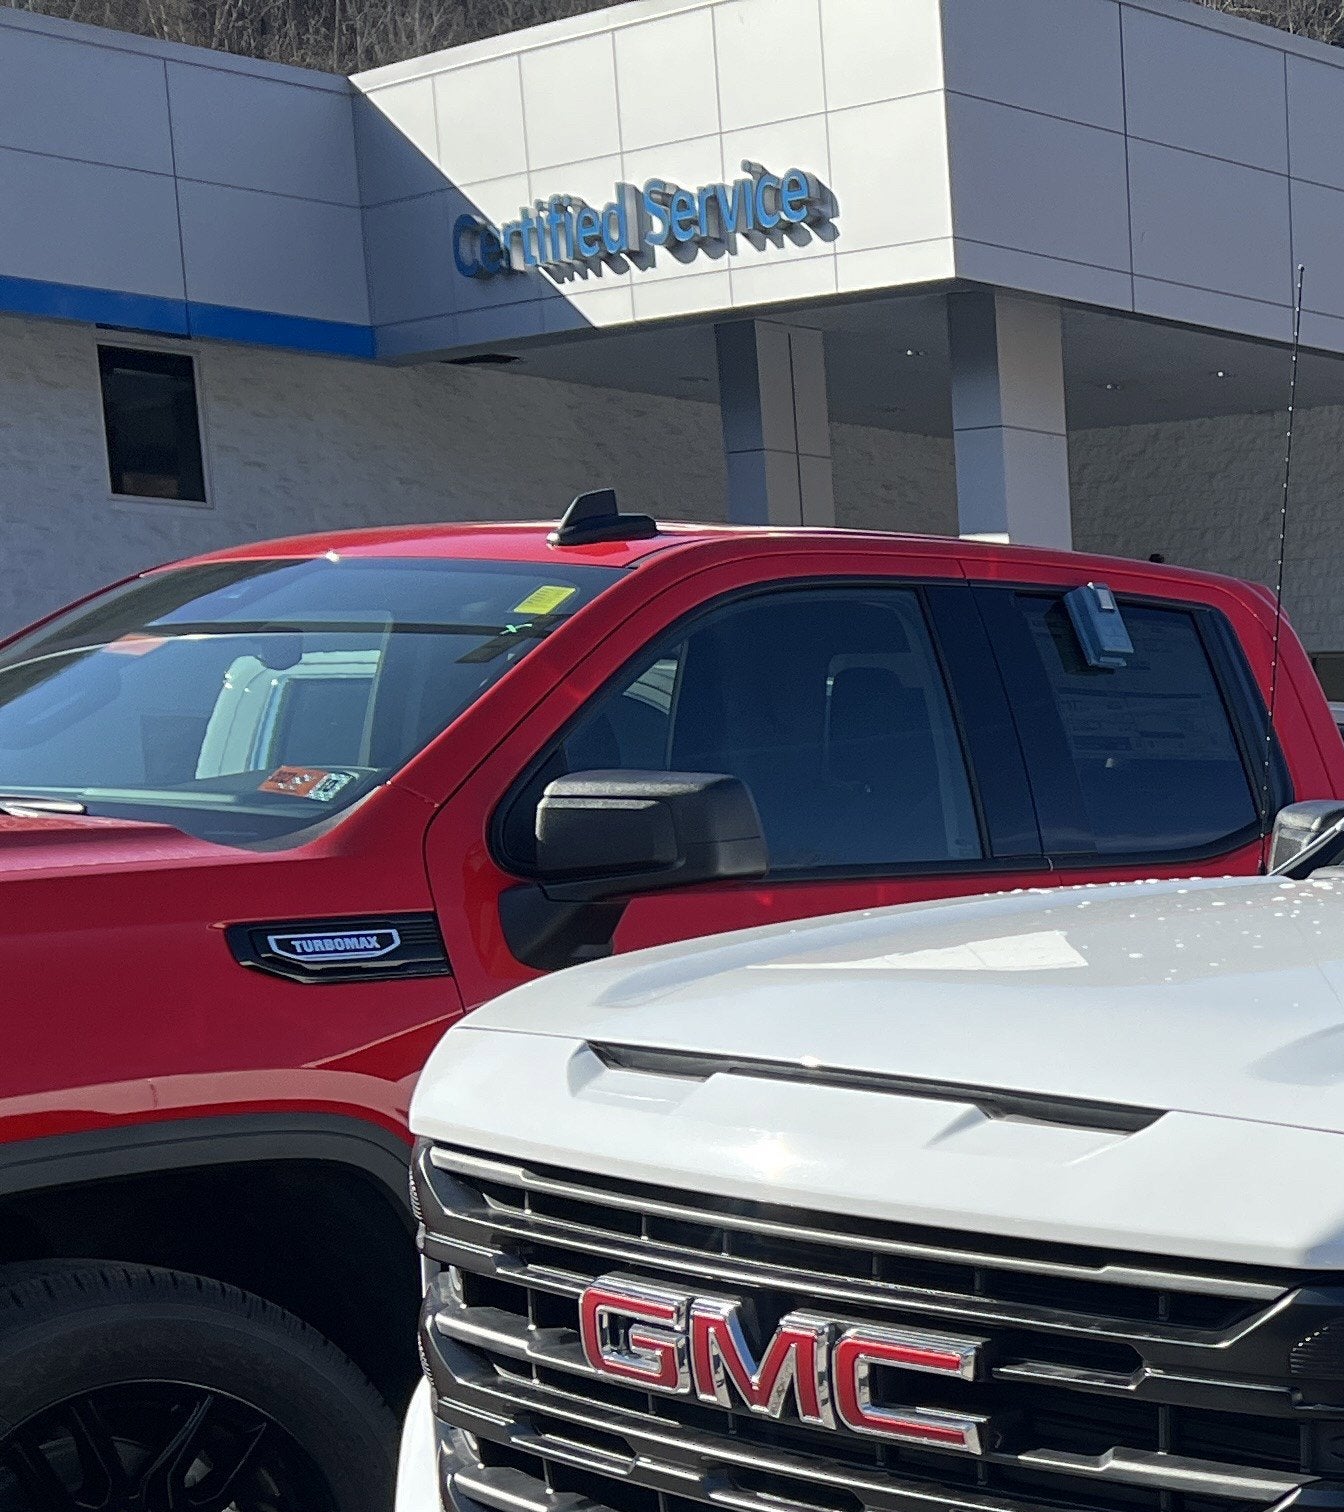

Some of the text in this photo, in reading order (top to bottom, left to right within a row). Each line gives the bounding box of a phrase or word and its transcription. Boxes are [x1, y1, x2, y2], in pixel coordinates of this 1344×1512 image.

[453, 159, 811, 279] Certified Service
[291, 935, 381, 953] TURBOMAX
[580, 1274, 984, 1456] GMC
